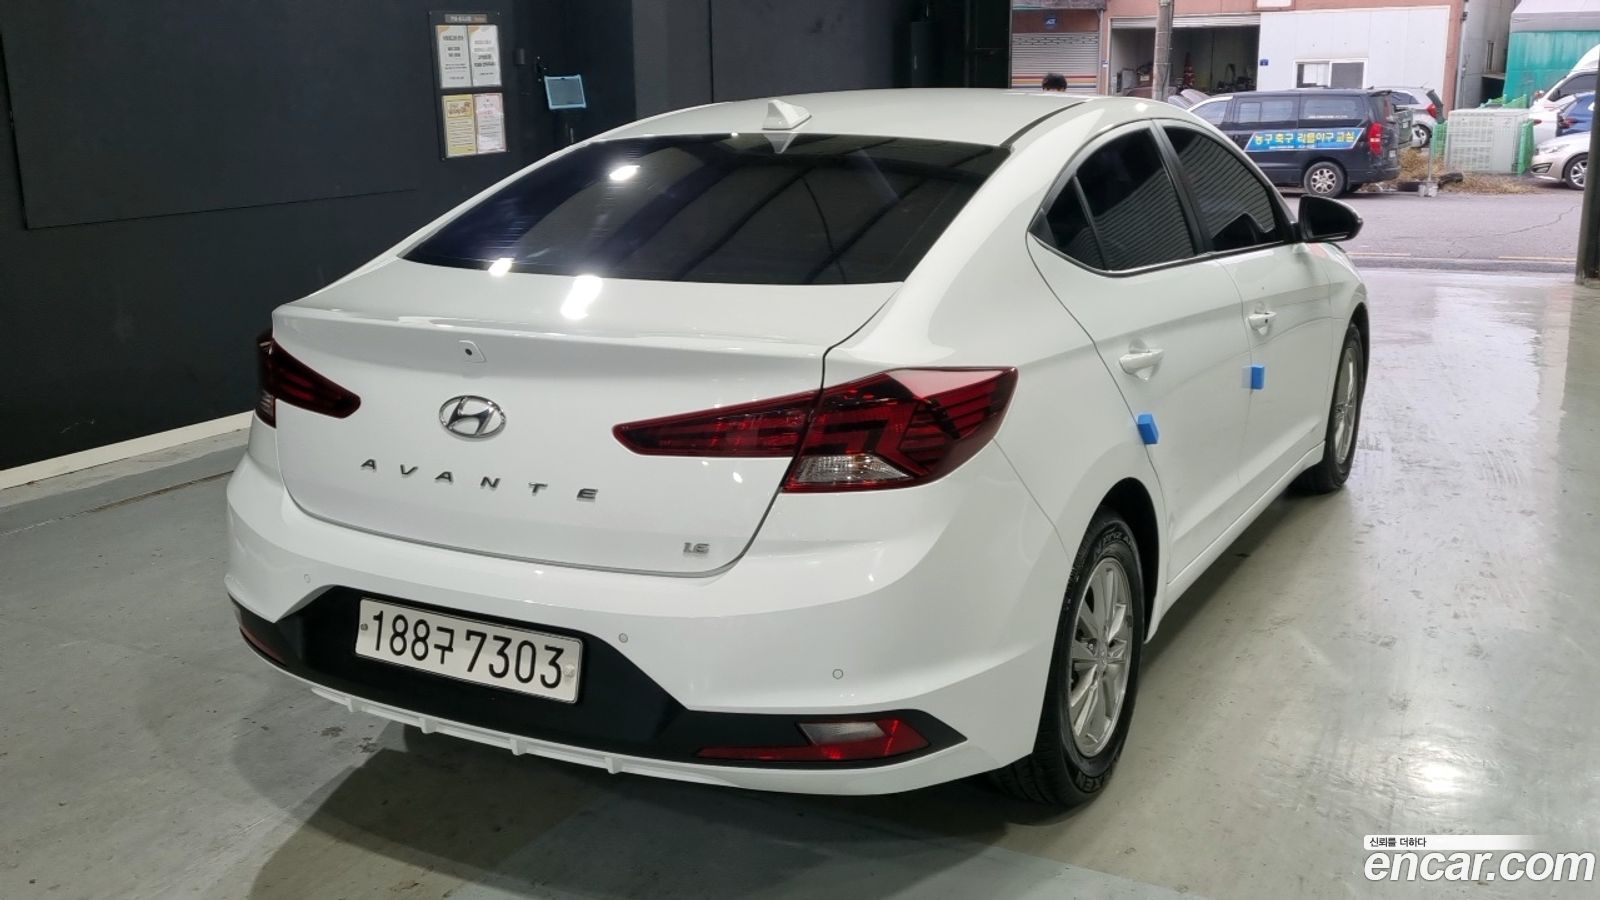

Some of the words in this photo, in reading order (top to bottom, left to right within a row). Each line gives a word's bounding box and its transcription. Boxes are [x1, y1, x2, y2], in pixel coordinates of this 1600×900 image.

[1255, 134, 1273, 145] 농구
[1276, 132, 1294, 144] 축구
[1336, 131, 1355, 143] 교실
[361, 458, 599, 501] AVANTE
[373, 610, 454, 664] 188구
[465, 629, 564, 689] 7303
